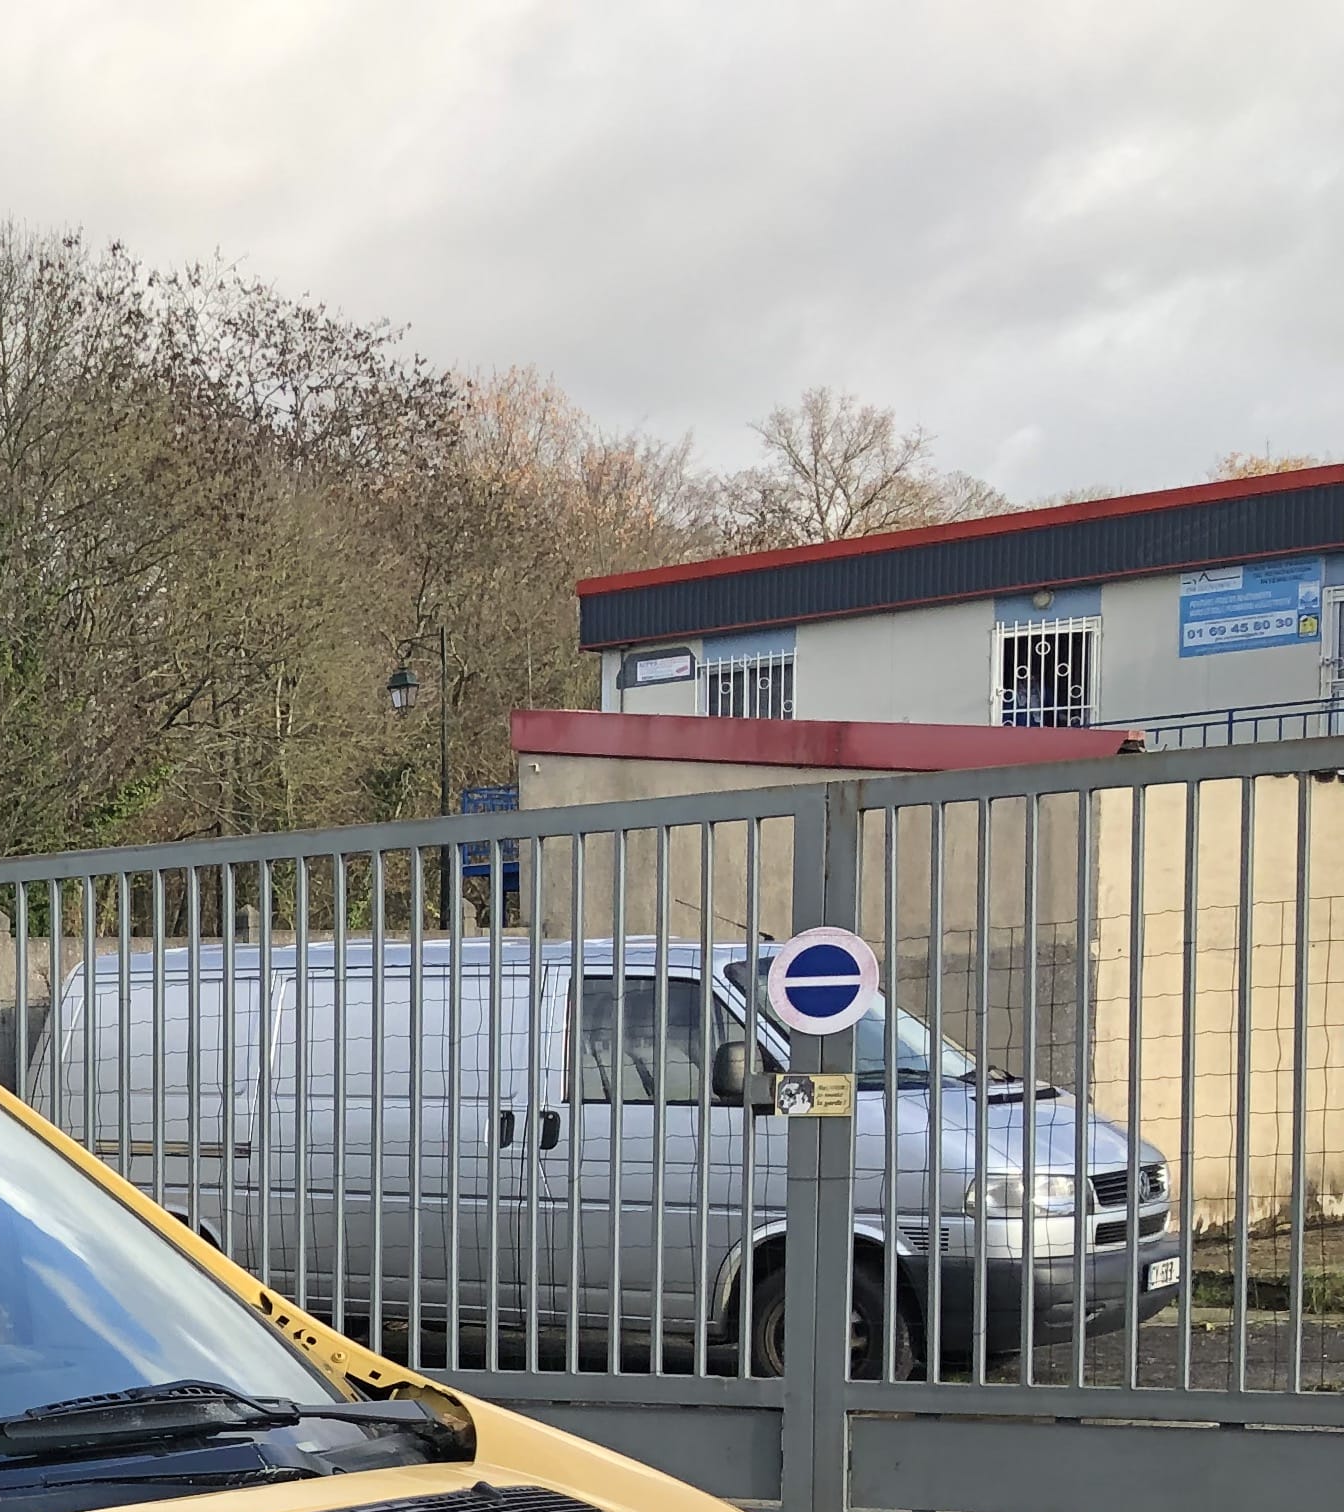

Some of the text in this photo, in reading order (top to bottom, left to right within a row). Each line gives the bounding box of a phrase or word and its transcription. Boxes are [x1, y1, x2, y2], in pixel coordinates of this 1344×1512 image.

[1186, 627, 1203, 640] 01
[1208, 624, 1227, 637] 69
[1230, 622, 1249, 634] 45
[1275, 616, 1294, 629] 30
